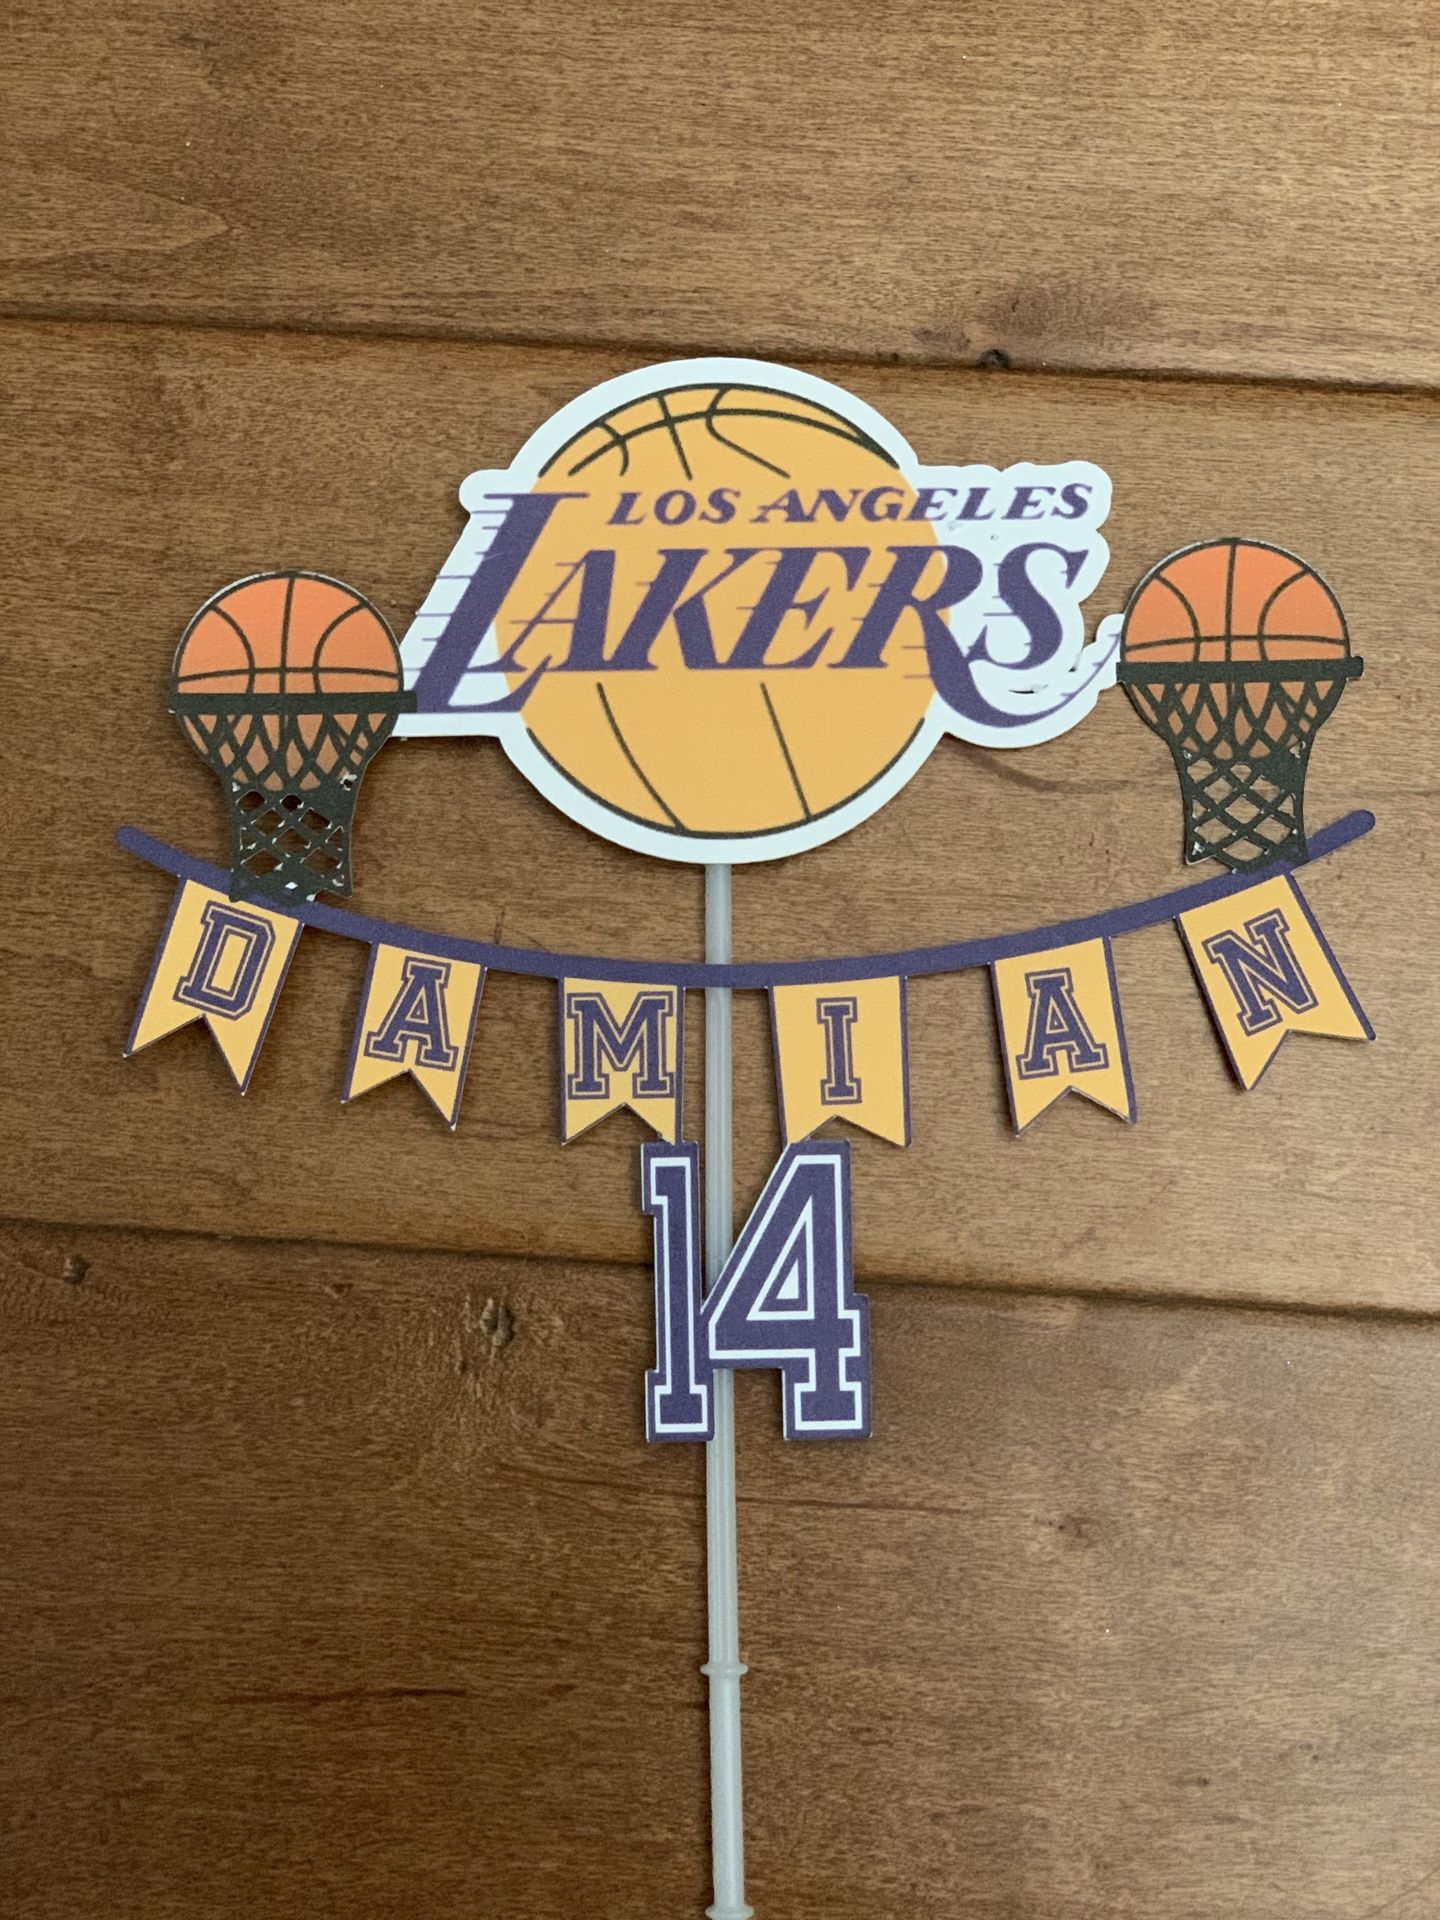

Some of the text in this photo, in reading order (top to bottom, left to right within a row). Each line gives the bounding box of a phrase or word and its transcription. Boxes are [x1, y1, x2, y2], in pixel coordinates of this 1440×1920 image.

[408, 491, 1121, 729] LAKERS
[606, 481, 1094, 526] LOS ANGELES
[172, 899, 1319, 1106] DAMIAN
[647, 1152, 865, 1435] 14
